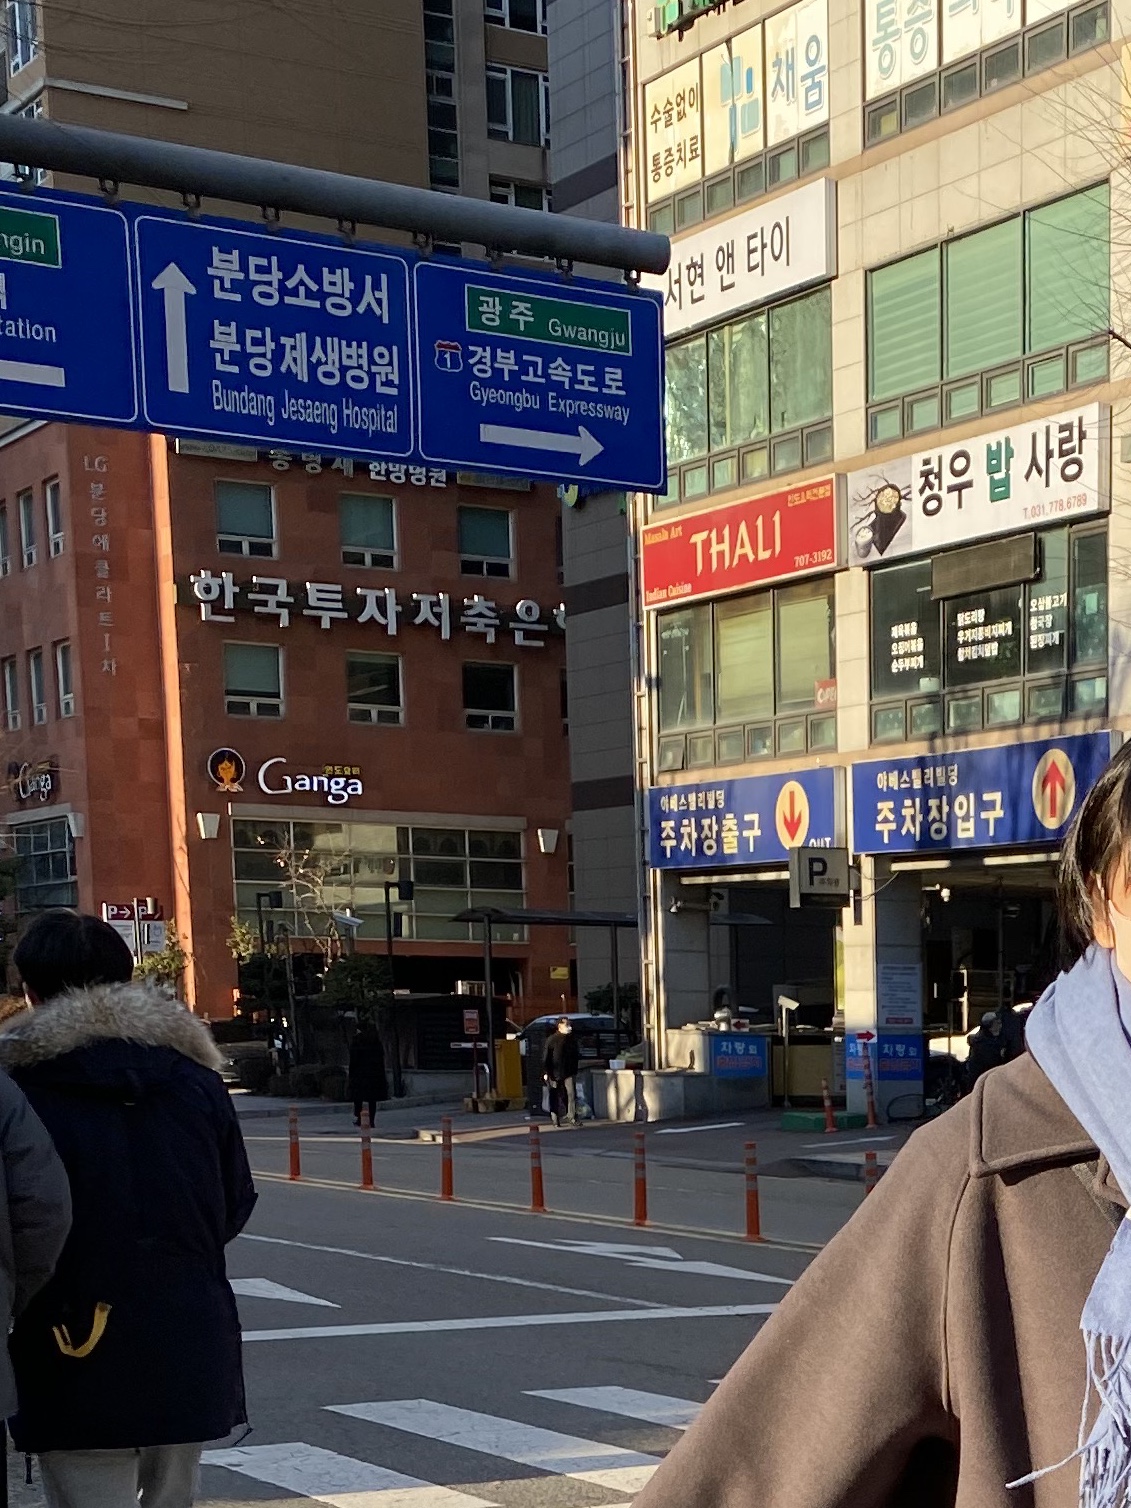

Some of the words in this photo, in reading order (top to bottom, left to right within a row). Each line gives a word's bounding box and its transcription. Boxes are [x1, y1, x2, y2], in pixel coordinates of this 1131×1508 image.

[772, 35, 827, 112] 채움
[650, 82, 699, 133] 수술없이
[650, 135, 700, 183] 통증치료
[207, 245, 389, 324] 분당소방서
[665, 252, 705, 311] 서현
[715, 246, 736, 290] 앤
[746, 214, 791, 278] 타이
[478, 296, 534, 331] 광주
[548, 318, 626, 350] Gwangju
[209, 319, 399, 395] 분당제생병원
[467, 345, 627, 395] 경부고속도로
[212, 379, 275, 426] Bundang
[281, 388, 338, 434] Jesaeng
[342, 397, 398, 437] Hospital
[469, 380, 540, 412] Gyeongbu
[548, 392, 630, 426] Expressway
[919, 449, 974, 517] 청우
[986, 435, 1015, 503] 밥
[1024, 415, 1087, 488] 사랑
[670, 525, 682, 539] Art
[689, 509, 781, 577] THALI
[793, 548, 832, 568] 707-3192
[646, 587, 667, 604] Indian
[258, 757, 363, 804] Ganga
[660, 813, 762, 859] 주차장출구
[875, 791, 1005, 844] 주차장입구
[808, 857, 827, 886] P
[108, 905, 118, 918] P
